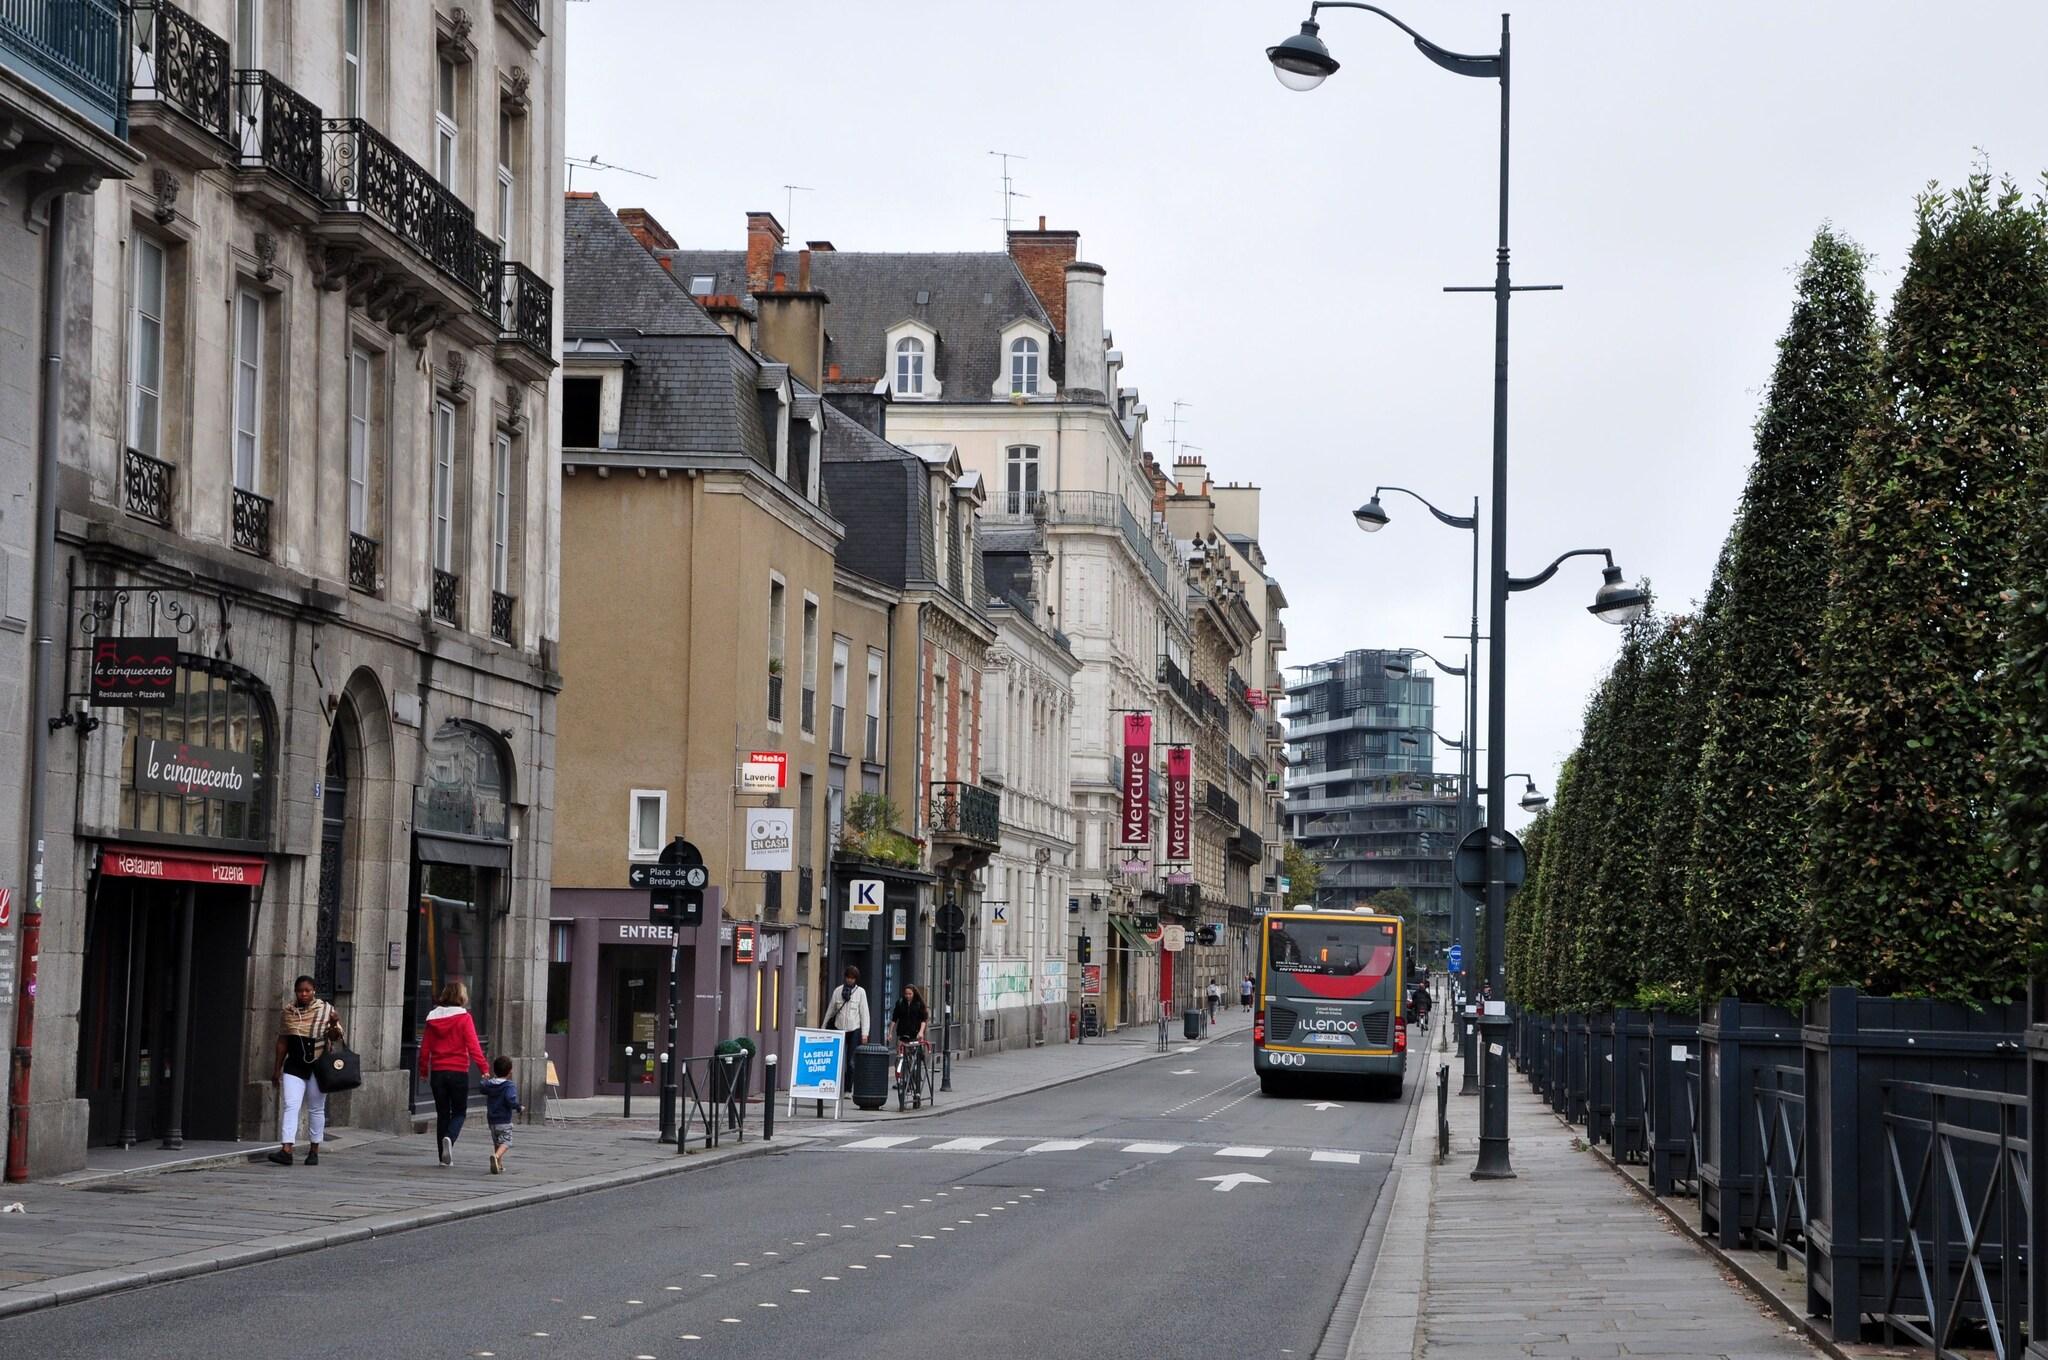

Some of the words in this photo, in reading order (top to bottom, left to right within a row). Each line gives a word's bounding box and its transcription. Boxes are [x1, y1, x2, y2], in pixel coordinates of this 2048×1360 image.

[94, 662, 104, 675] le
[106, 665, 173, 678] cinquecento
[752, 754, 785, 762] Miele
[147, 740, 159, 779] le
[163, 754, 242, 793] cinquecento
[744, 773, 775, 781] Laverie
[1128, 752, 1144, 841] Mercure
[1172, 780, 1185, 857] Mercure
[751, 820, 788, 840] OR
[753, 841, 764, 849] EN
[765, 839, 787, 848] CASH
[649, 867, 671, 876] Place
[675, 868, 686, 877] de
[649, 877, 686, 888] Bretagne
[858, 883, 876, 905] K
[994, 907, 1005, 920] K
[813, 1050, 834, 1058] SEULE
